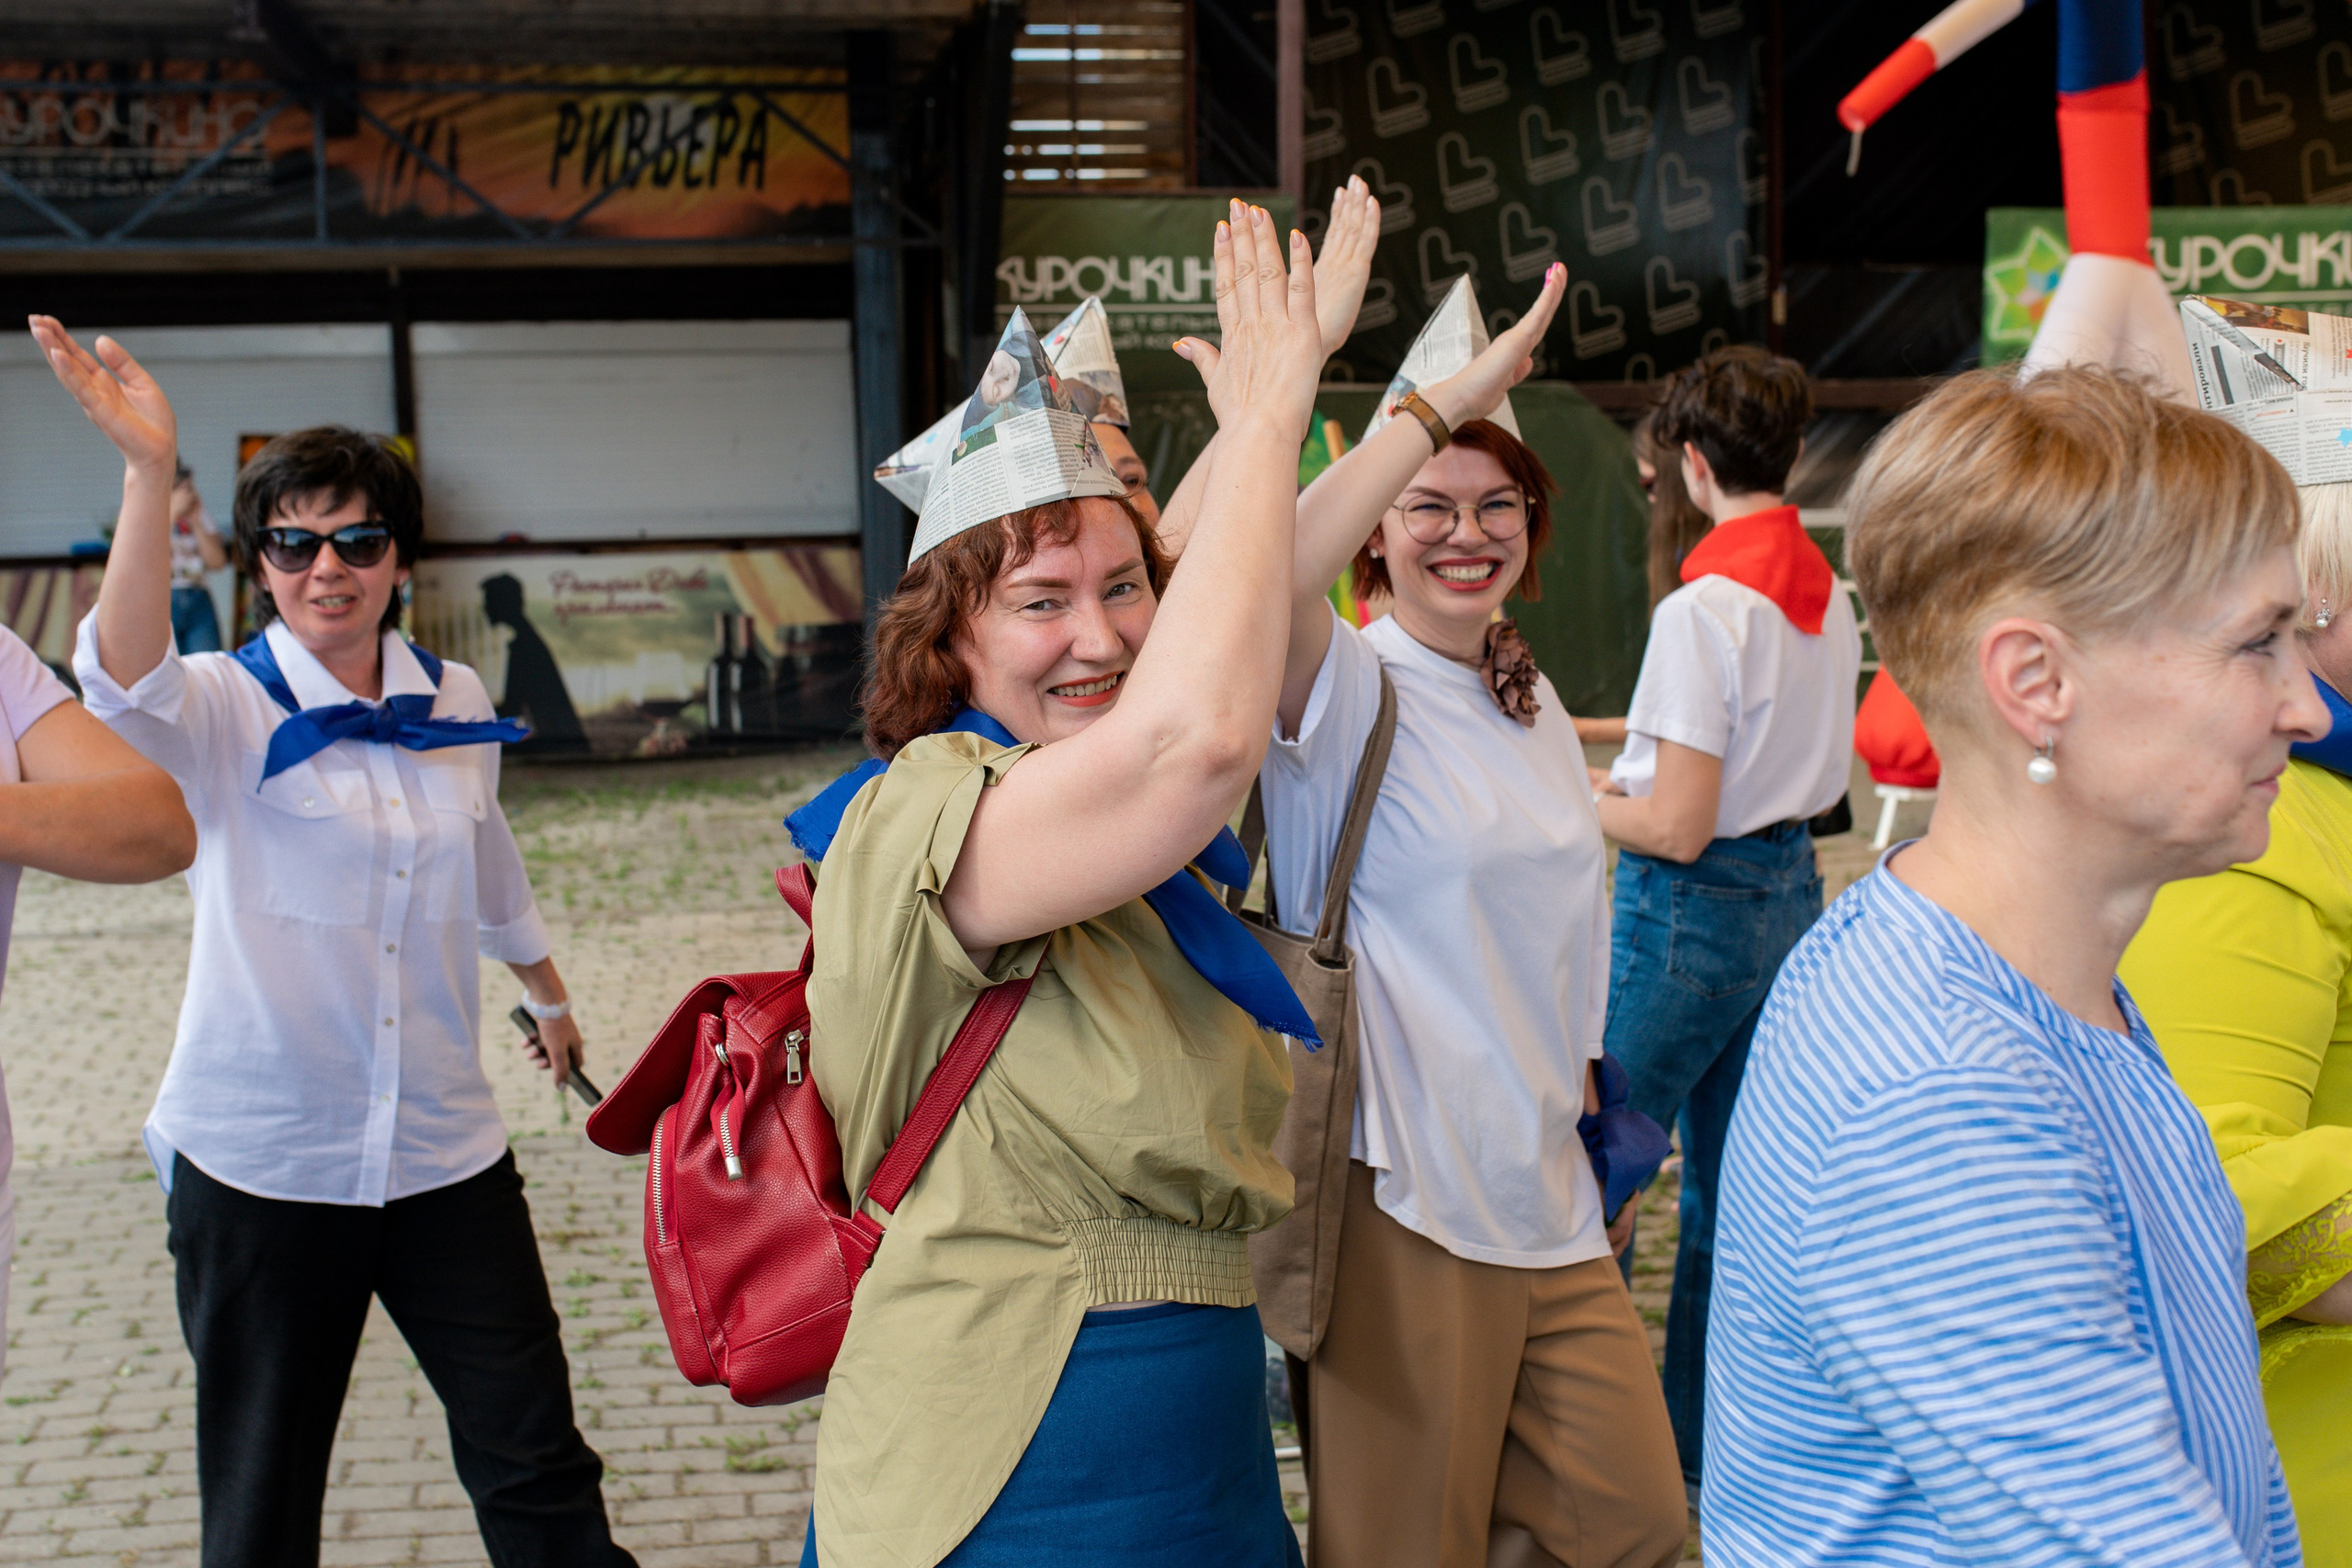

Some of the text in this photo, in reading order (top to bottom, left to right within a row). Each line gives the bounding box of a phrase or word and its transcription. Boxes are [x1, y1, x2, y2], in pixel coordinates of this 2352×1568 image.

[0, 97, 266, 144] УРОЧКИНО
[551, 99, 768, 190] РИВЬЕРА
[2148, 232, 2352, 292] УРОЧК
